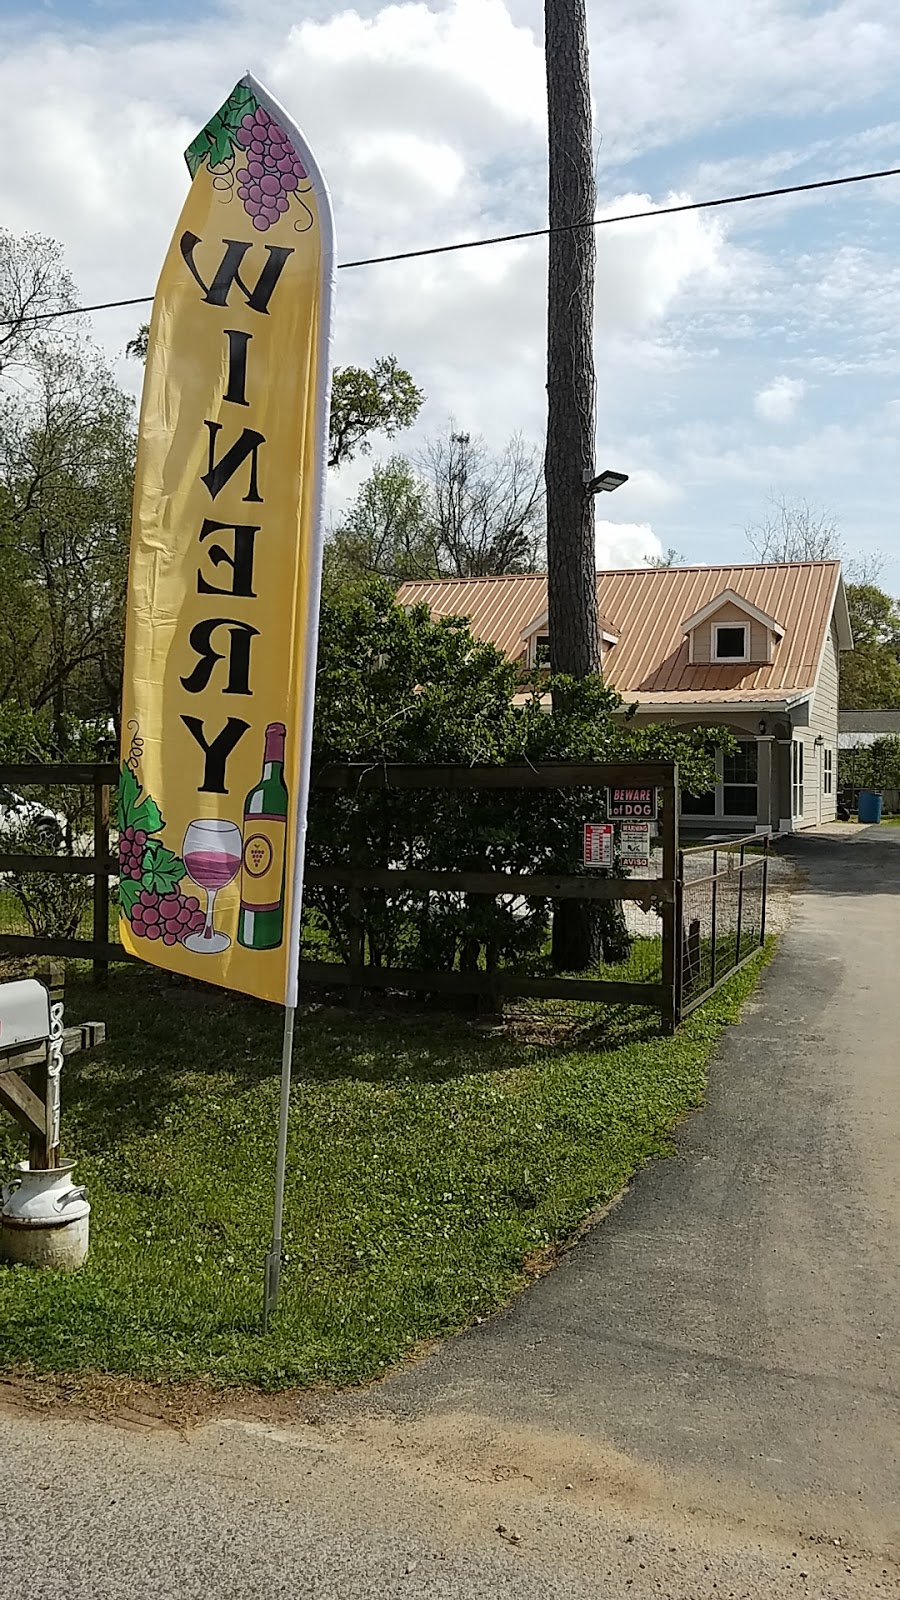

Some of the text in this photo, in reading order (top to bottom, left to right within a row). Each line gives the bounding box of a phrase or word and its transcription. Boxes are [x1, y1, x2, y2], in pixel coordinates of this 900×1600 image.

[613, 789, 651, 800] BEWARE
[613, 804, 652, 815] of DOG
[48, 1001, 64, 1149] 8311
